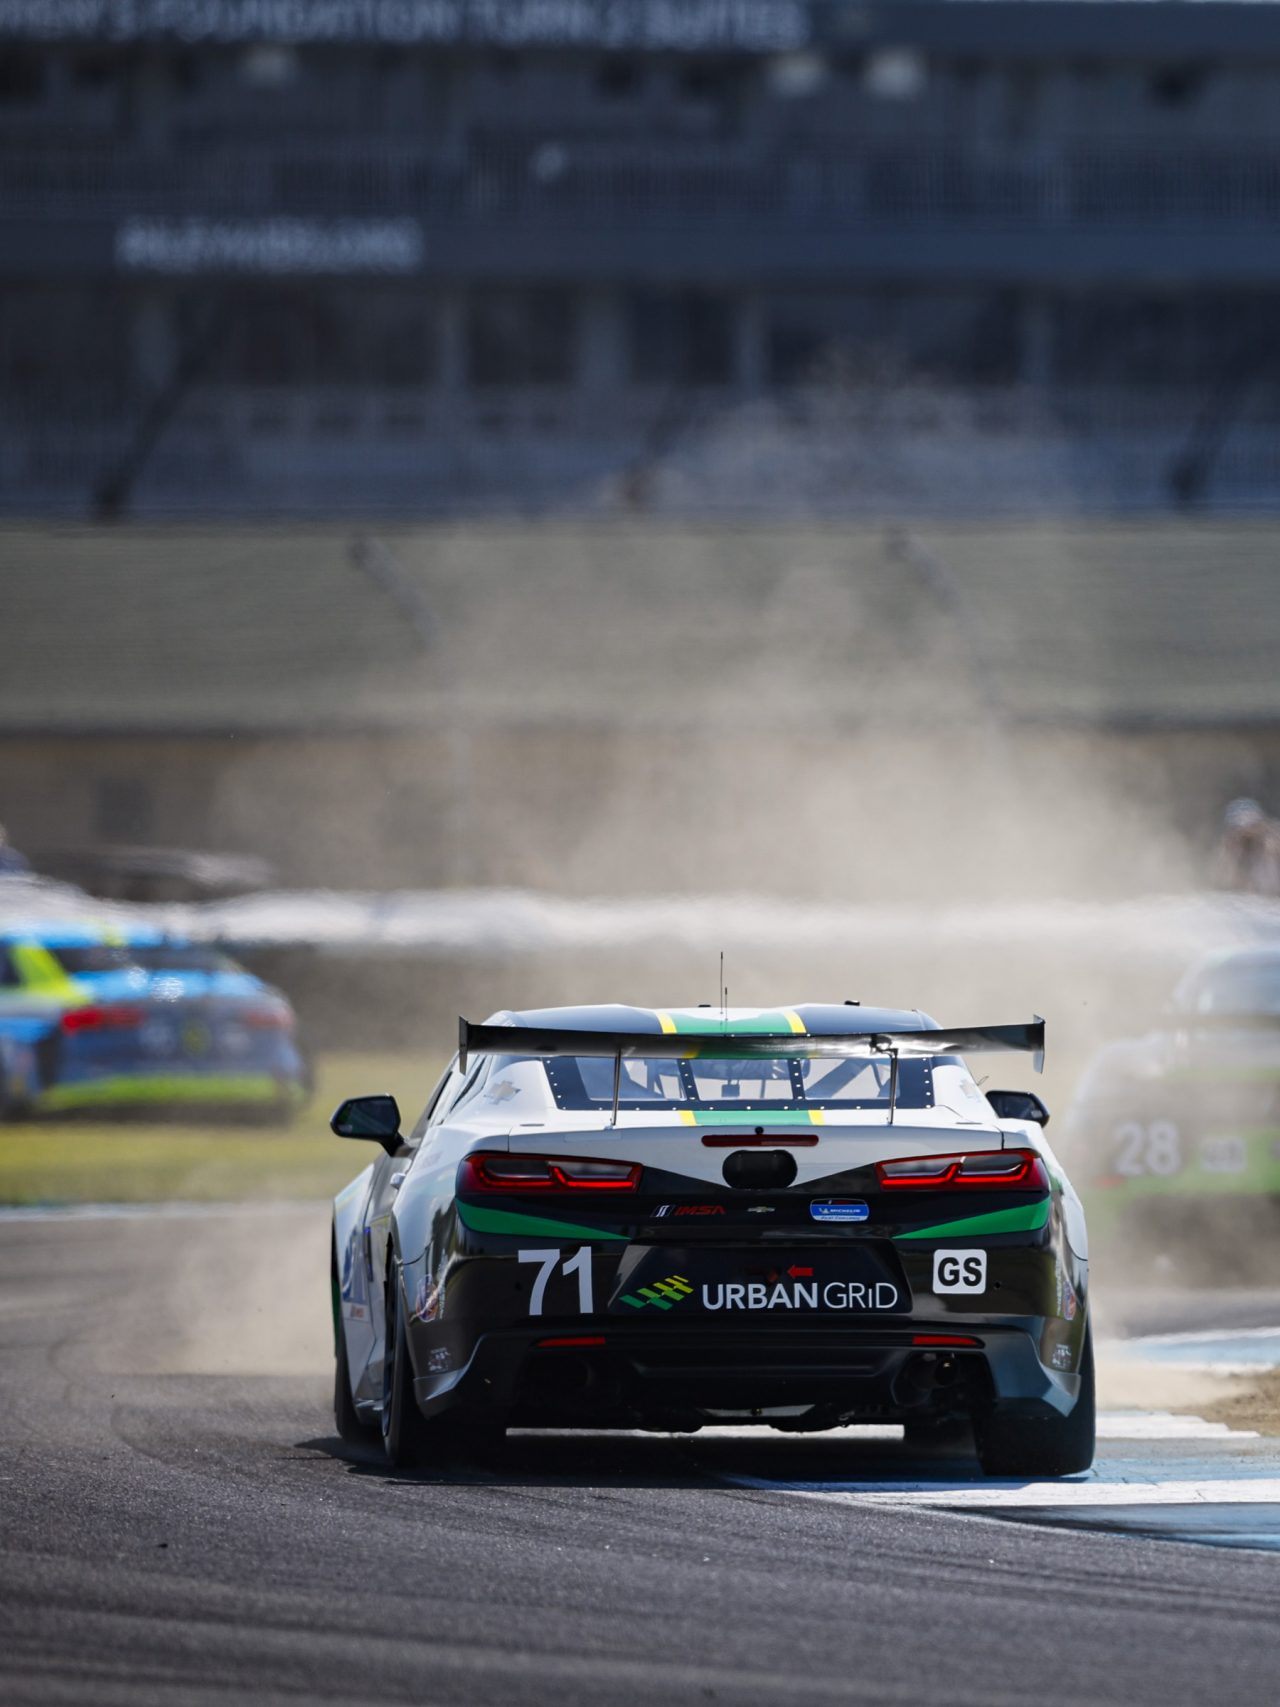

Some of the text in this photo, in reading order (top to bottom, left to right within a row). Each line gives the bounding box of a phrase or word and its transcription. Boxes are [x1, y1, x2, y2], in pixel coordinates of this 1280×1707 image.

[1113, 1119, 1182, 1176] 28
[518, 1246, 594, 1315] 71
[938, 1257, 982, 1287] GS
[702, 1282, 818, 1310] URBAN
